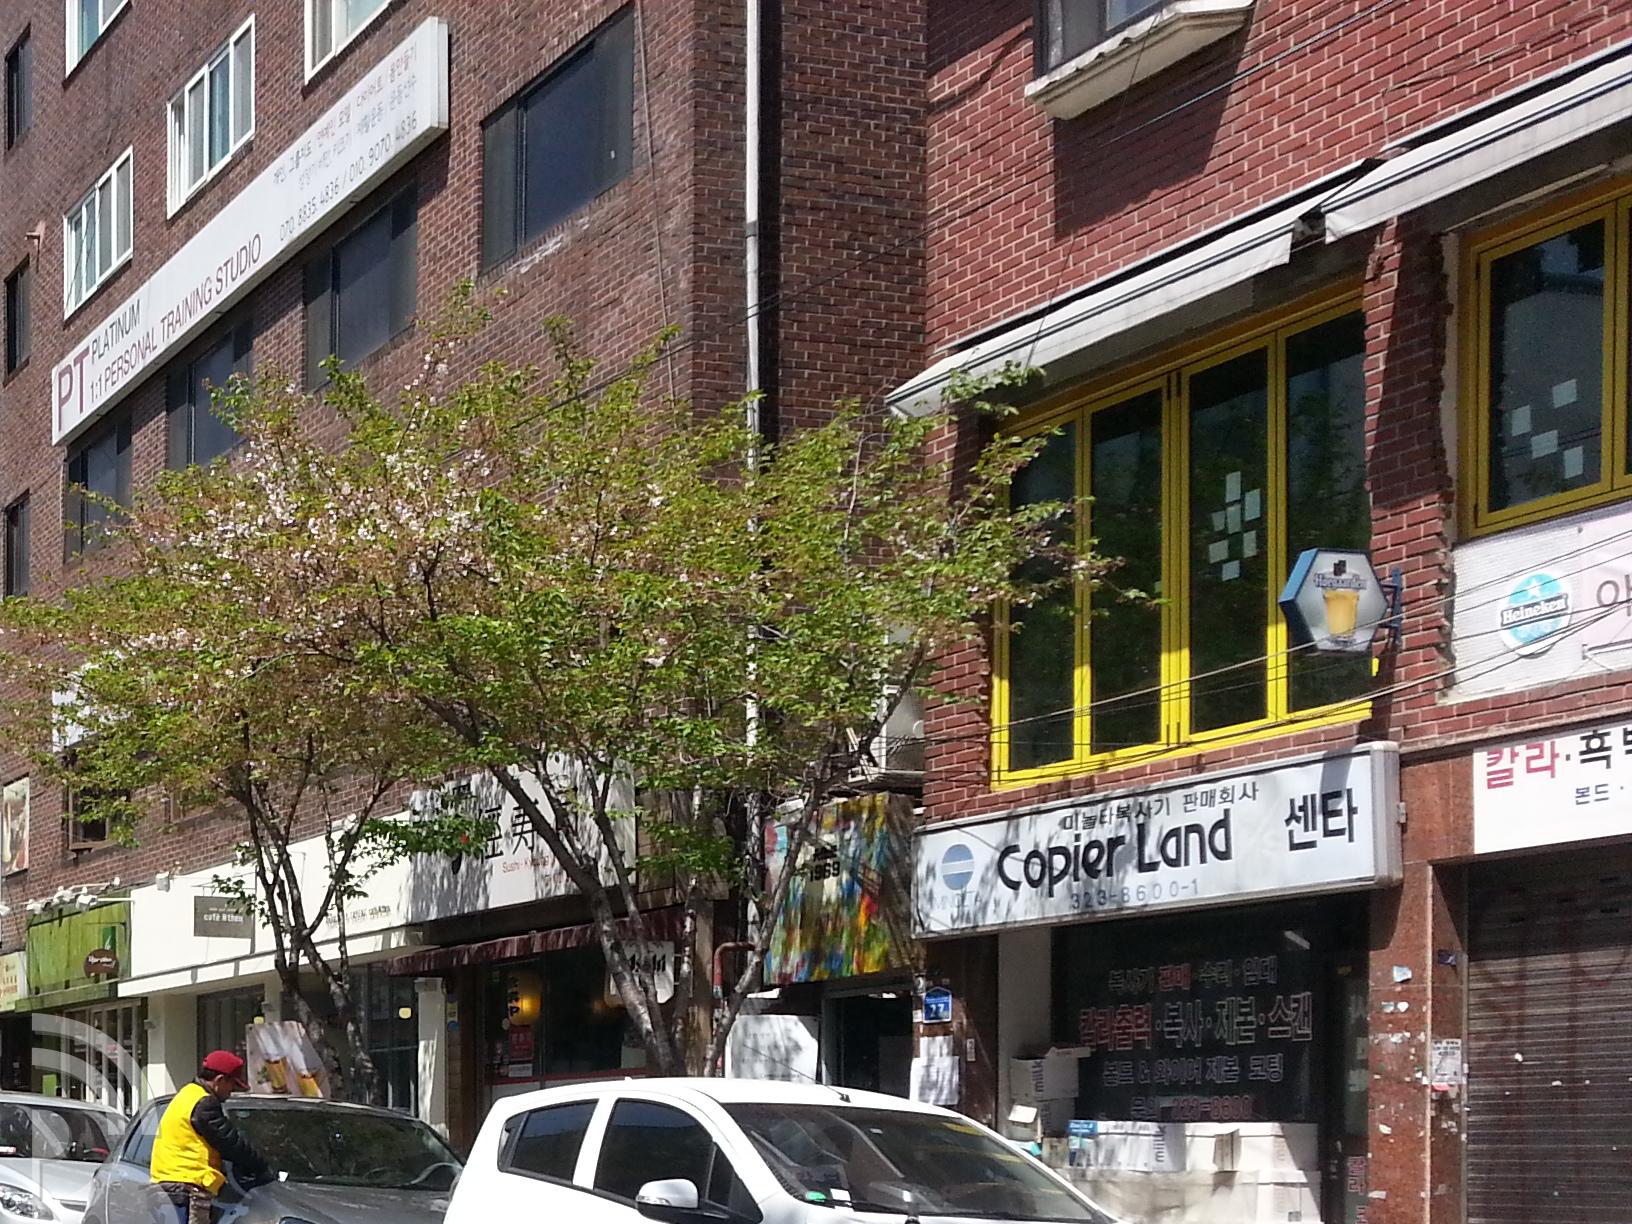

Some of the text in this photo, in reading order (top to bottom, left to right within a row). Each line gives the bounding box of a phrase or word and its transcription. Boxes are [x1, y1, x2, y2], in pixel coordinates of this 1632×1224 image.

[90, 233, 262, 403] 1:1 PERSONAL TRAINING STUDIO
[91, 298, 141, 365] PLATINUM
[57, 344, 90, 432] PT
[1502, 596, 1566, 624] Heineken
[1063, 781, 1259, 831] 미놀타복사기 판매회사
[1575, 784, 1609, 805] 본드
[1284, 788, 1359, 851] 센타
[810, 861, 840, 882] 1969
[997, 808, 1233, 898] Copier Land
[1071, 878, 1199, 909] 323-8600-1
[930, 1003, 944, 1017] 27
[1206, 1055, 1239, 1083] 제본
[1249, 1053, 1284, 1082] 코팅
